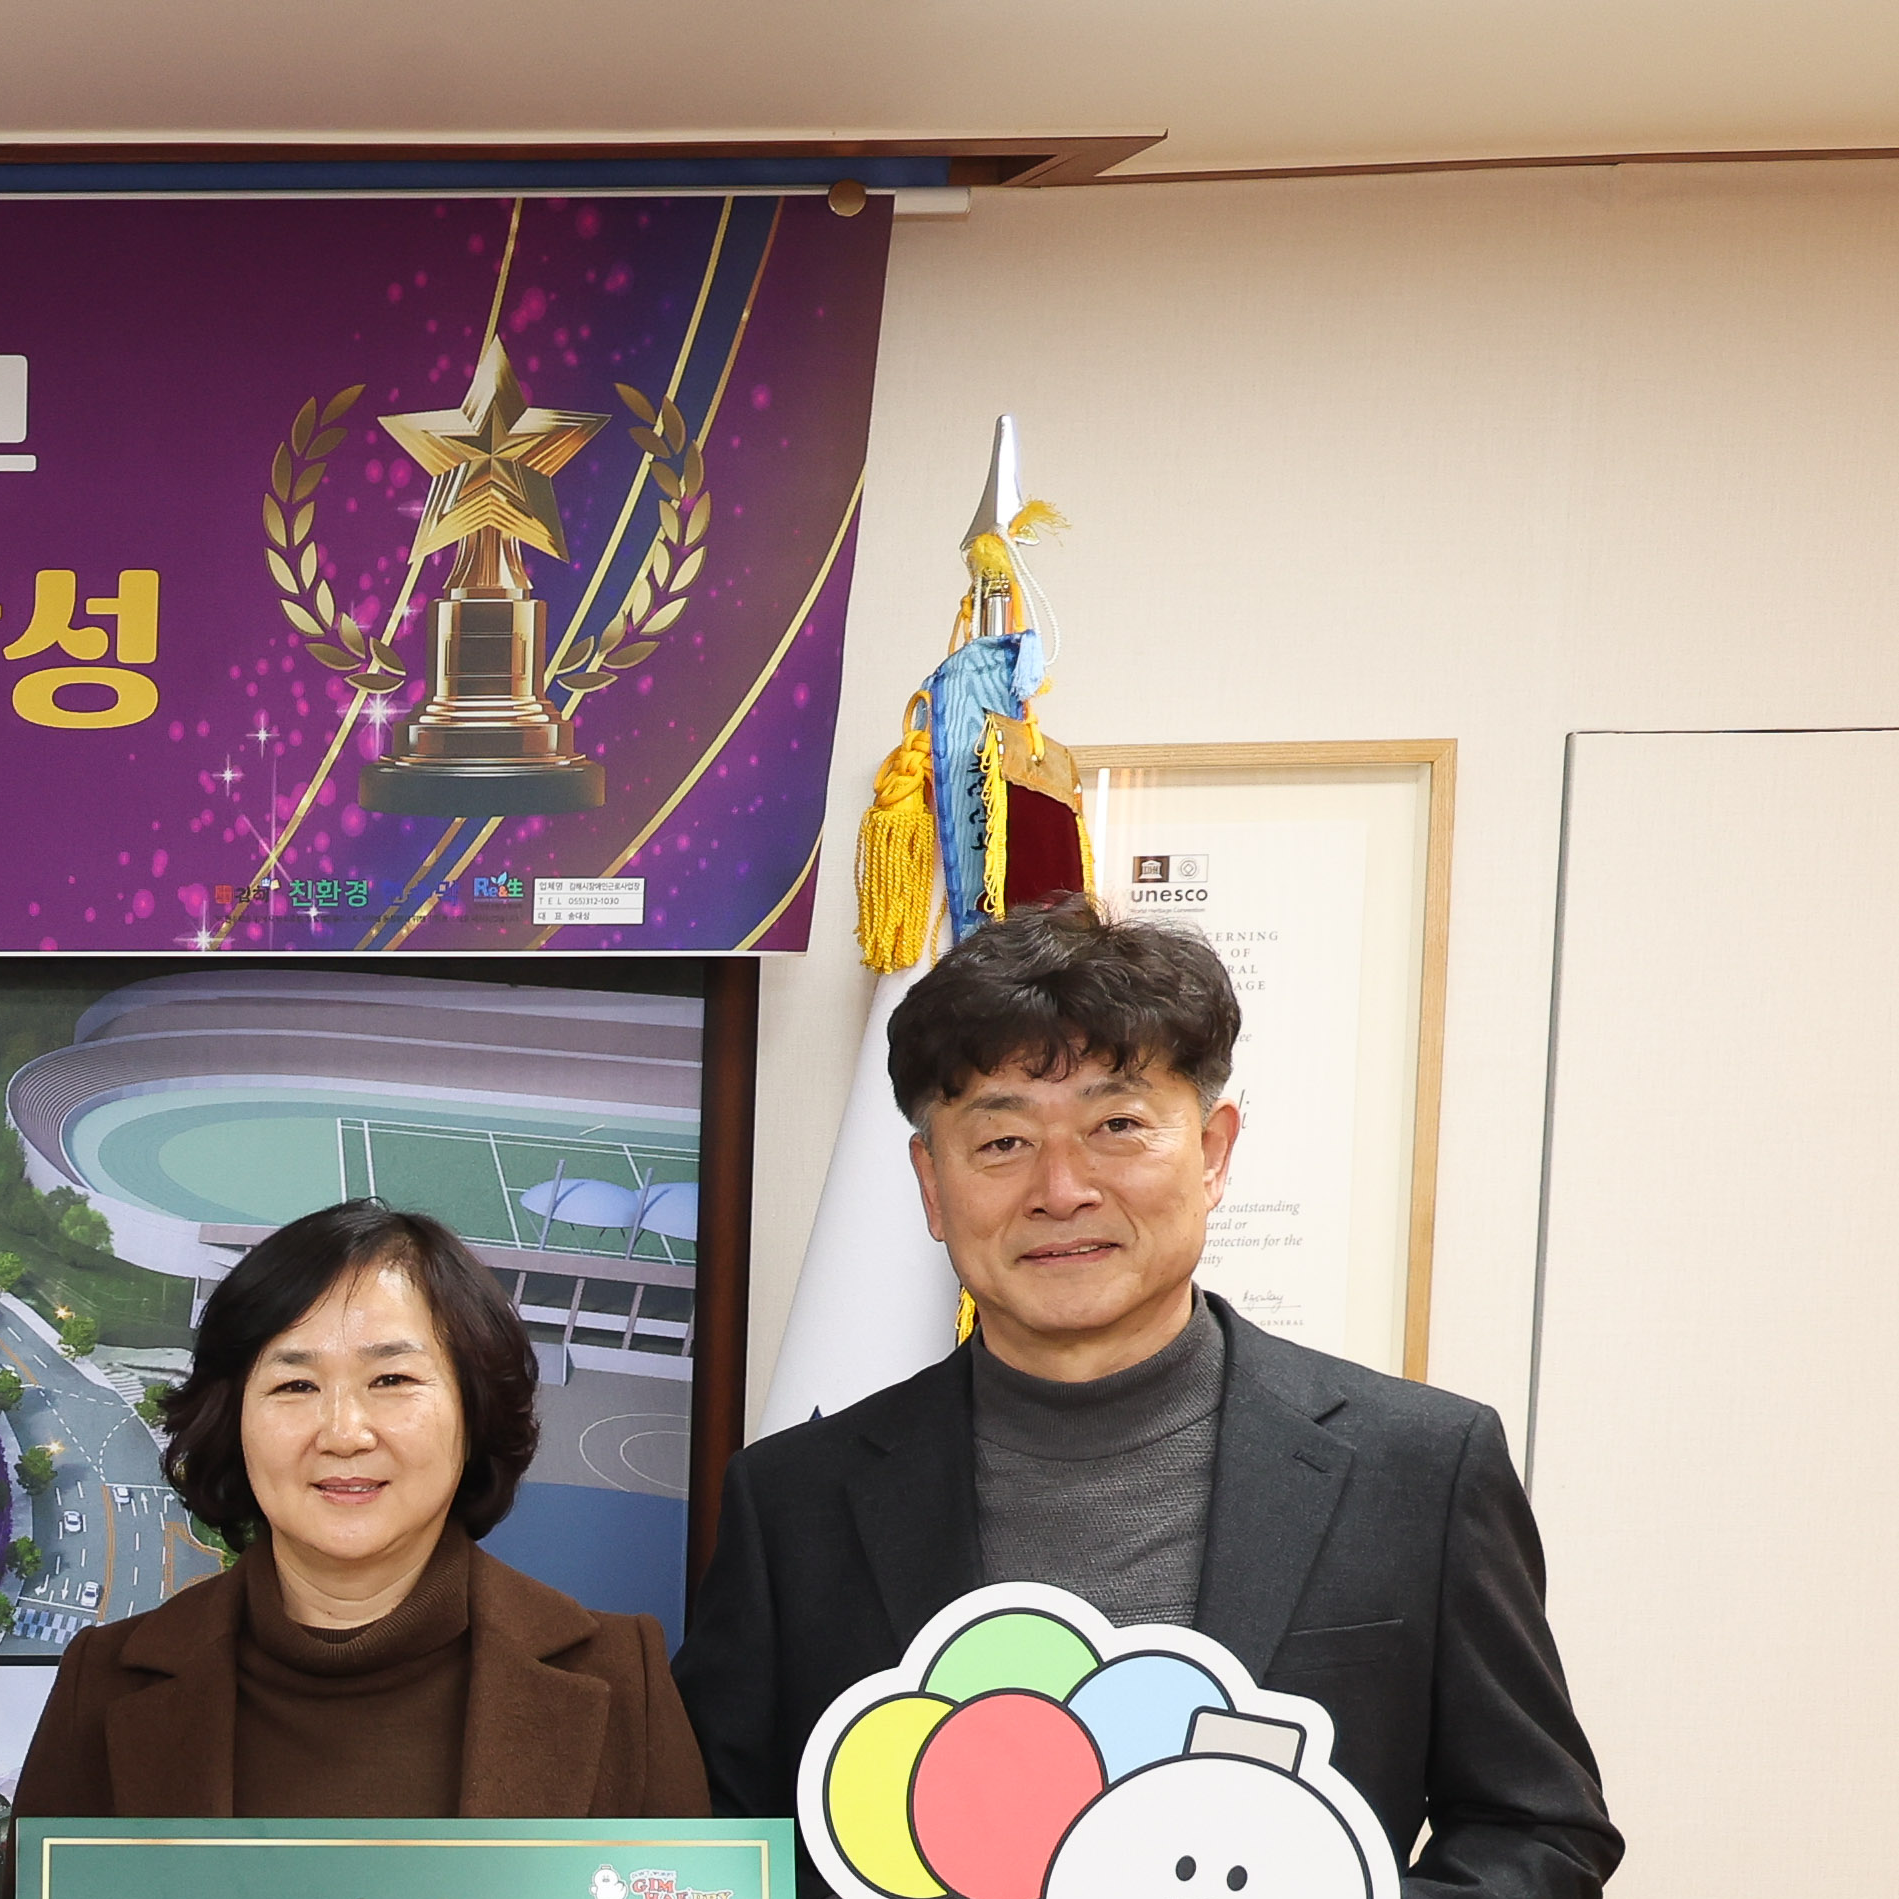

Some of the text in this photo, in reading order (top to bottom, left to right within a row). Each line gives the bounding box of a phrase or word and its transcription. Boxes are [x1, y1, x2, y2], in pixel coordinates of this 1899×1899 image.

[289, 879, 368, 907] 친환경
[1130, 888, 1208, 903] unesco
[1203, 931, 1279, 942] CERNING
[1230, 948, 1251, 958] OF
[1228, 1200, 1300, 1216] outstanding
[1206, 1218, 1248, 1230] ural or
[1206, 1233, 1303, 1250] rotection for the
